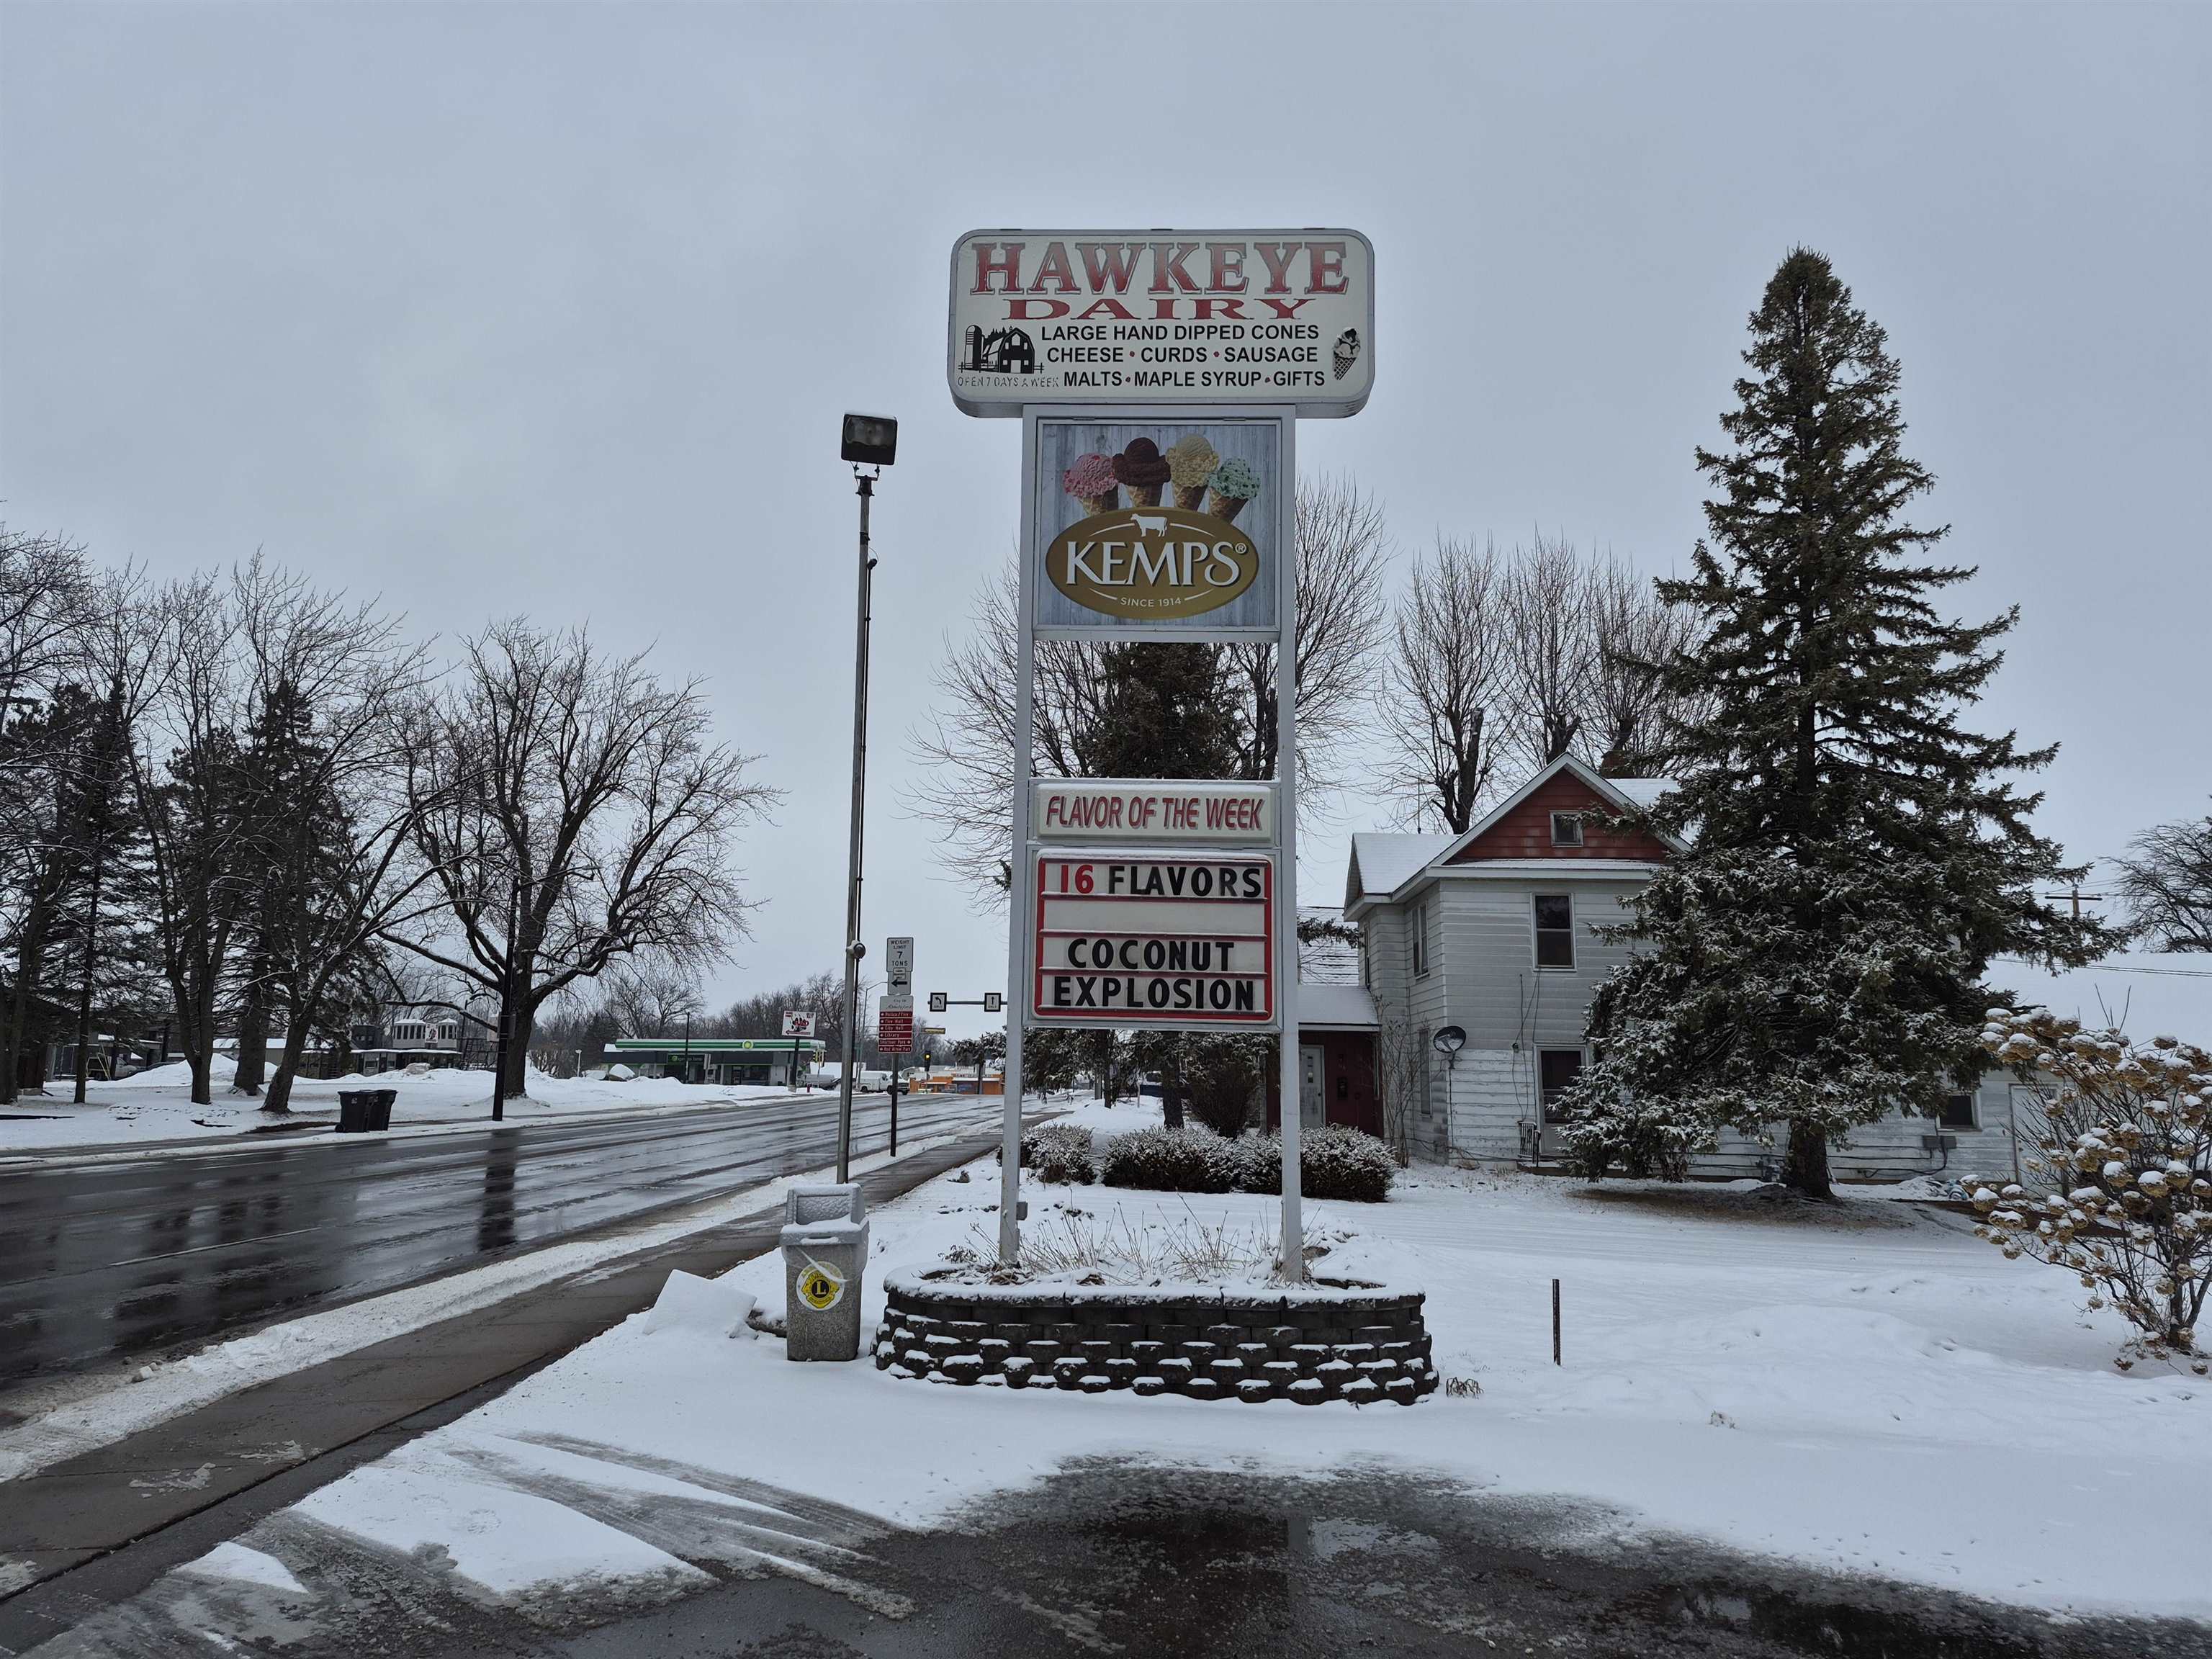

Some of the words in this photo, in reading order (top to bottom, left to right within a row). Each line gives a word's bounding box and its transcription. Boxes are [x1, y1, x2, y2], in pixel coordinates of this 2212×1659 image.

[969, 241, 1350, 295] HAWKEYE
[1001, 298, 1316, 320] DAIRY
[1041, 325, 1109, 341] LARGE
[1113, 325, 1169, 341] HAND
[1174, 324, 1244, 341] DIPPED
[1246, 324, 1319, 340] CONES
[1047, 346, 1124, 363] CHEESE
[1141, 346, 1208, 363] CURDS
[1223, 346, 1318, 363] SAUSAGE
[986, 377, 990, 387] 7
[1064, 372, 1123, 387] MALTS
[1133, 371, 1196, 387] MAPLE
[1201, 371, 1262, 387] SYRUP
[1273, 371, 1326, 387] GIFTS
[1120, 597, 1154, 608] SINCE
[1159, 597, 1182, 607] 1914
[1046, 796, 1124, 829] FLAVOR
[1128, 796, 1156, 828] OF
[1162, 797, 1200, 829] THE
[1205, 798, 1265, 830] WEEK
[1060, 864, 1094, 894] 16
[1108, 865, 1261, 898] FLAVORS
[896, 950, 903, 959] 7
[1067, 938, 1234, 971] COCONUT
[1054, 976, 1254, 1010] EXPLOSION
[815, 1281, 827, 1295] L
